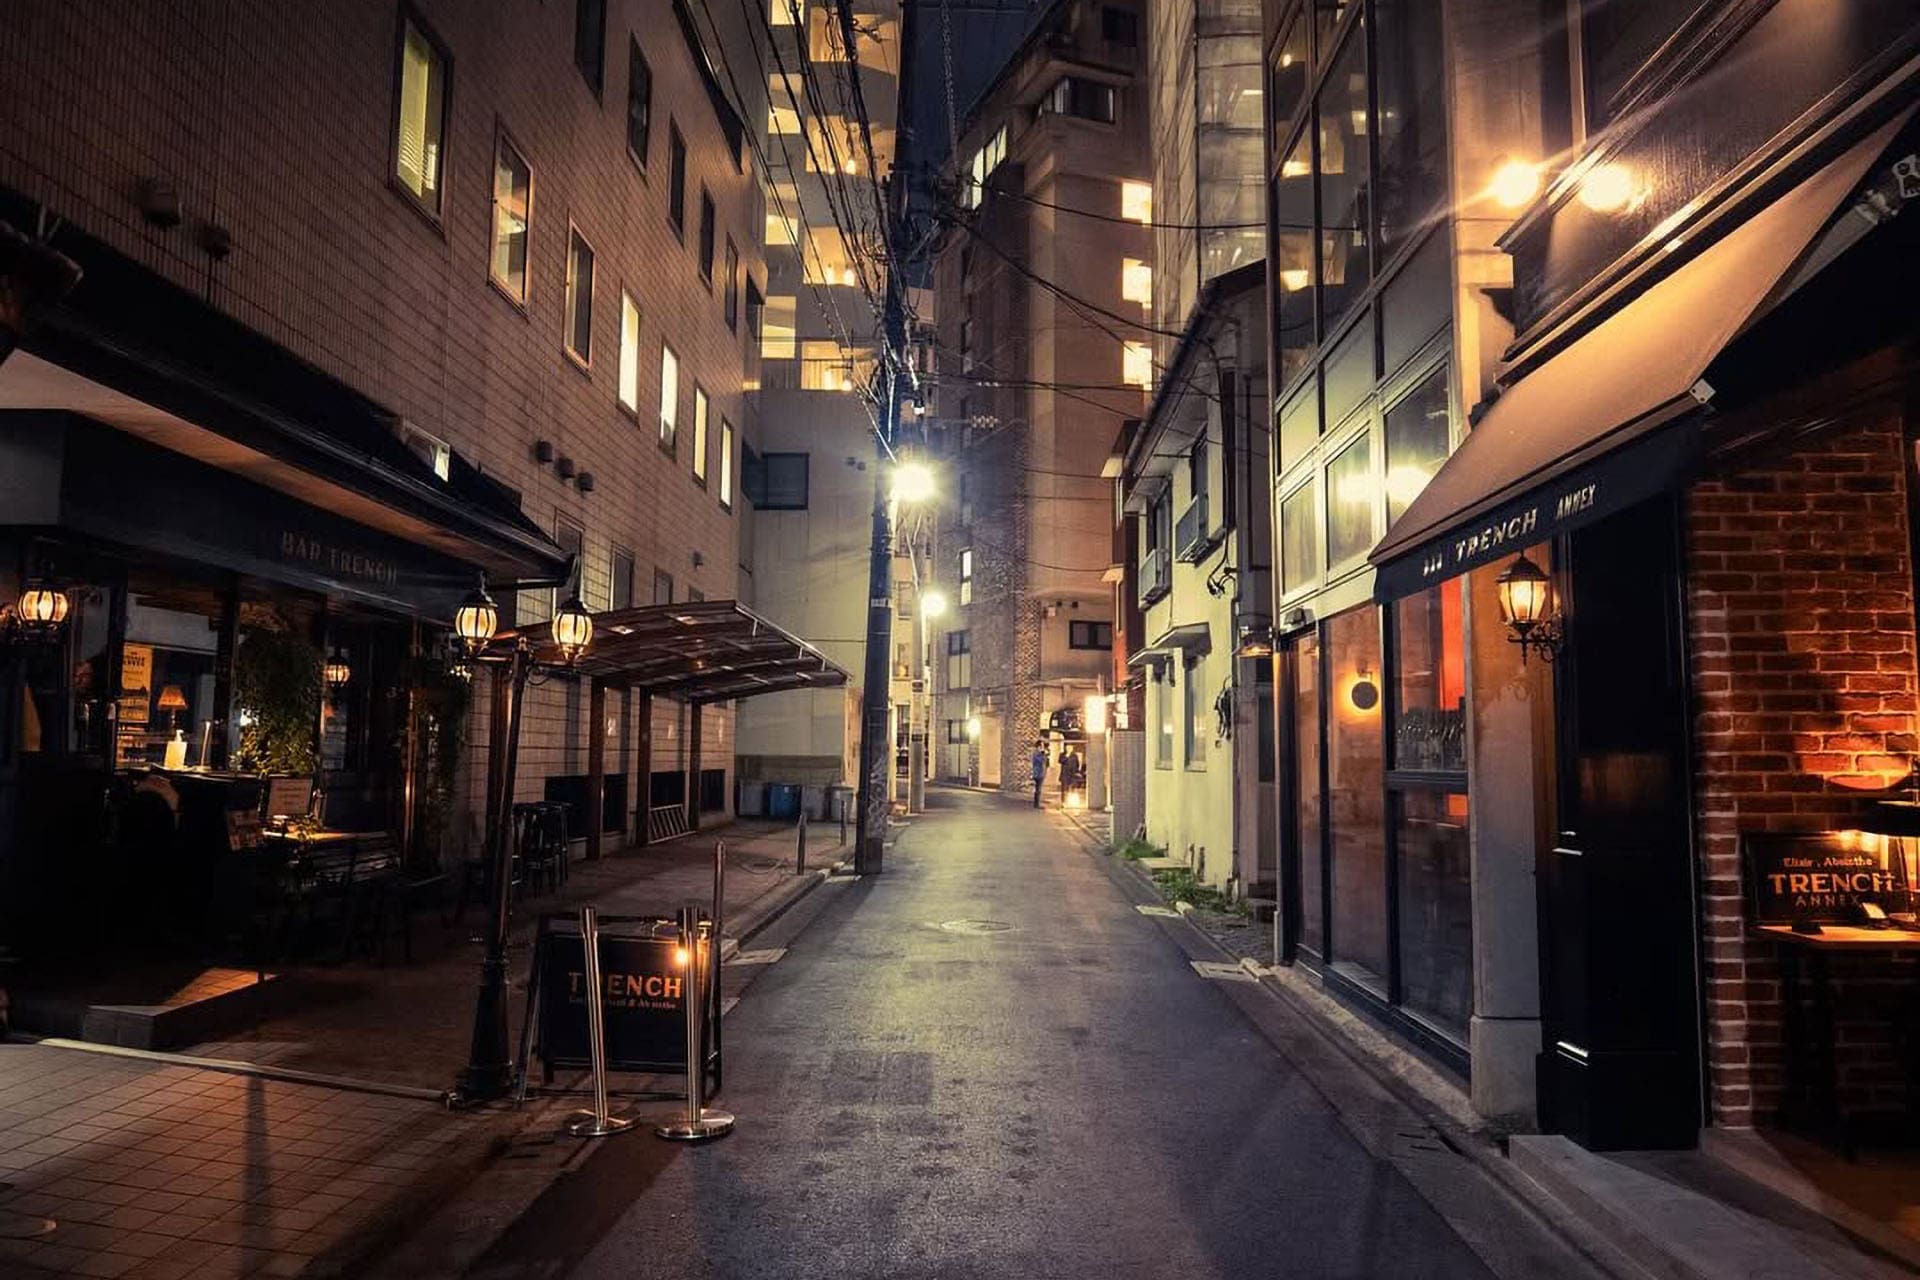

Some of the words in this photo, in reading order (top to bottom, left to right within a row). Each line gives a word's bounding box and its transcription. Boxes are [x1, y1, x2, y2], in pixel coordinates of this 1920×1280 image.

[1455, 507, 1537, 562] TRENCH
[1554, 484, 1596, 520] ANNEX
[330, 547, 398, 587] TRENCH
[1767, 872, 1895, 895] TRENCH
[1795, 894, 1860, 907] ANNEX
[567, 971, 682, 999] TENCH
